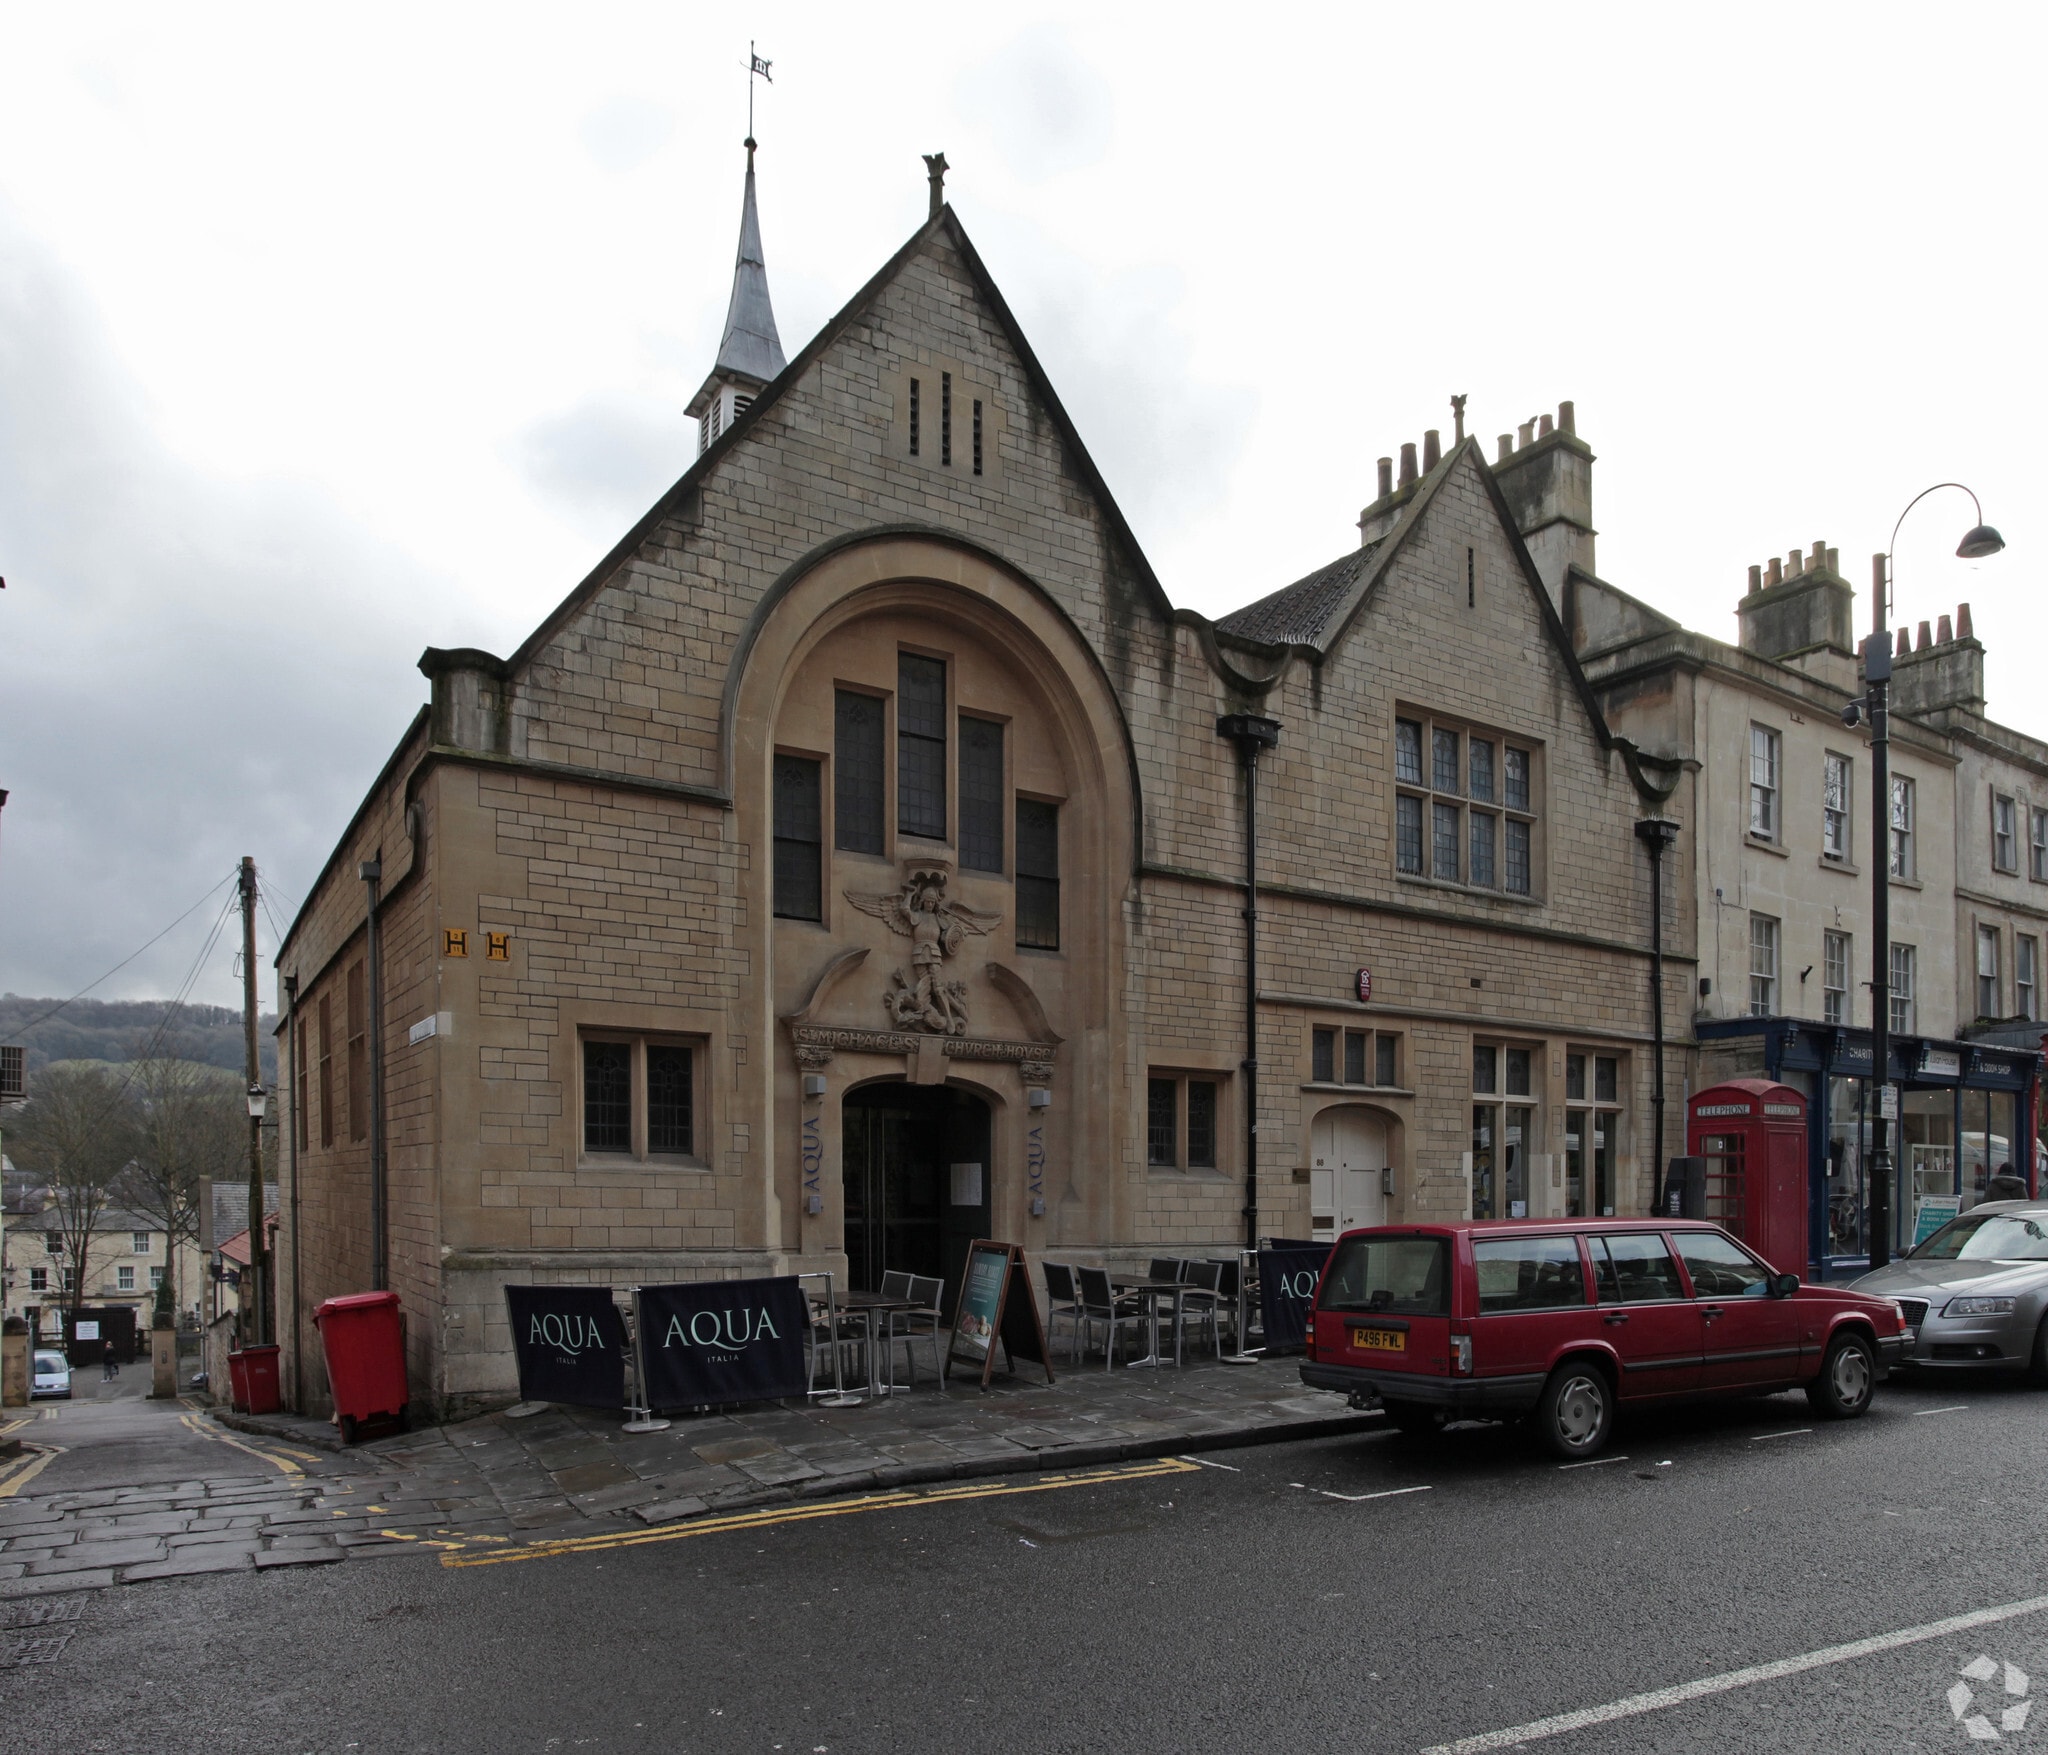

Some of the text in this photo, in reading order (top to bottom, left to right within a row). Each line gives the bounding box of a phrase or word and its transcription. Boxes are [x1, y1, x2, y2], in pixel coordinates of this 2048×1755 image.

[1998, 1064, 2011, 1075] SHOP
[1700, 1104, 1748, 1115] TELEPHONE
[1766, 1104, 1799, 1114] TELEPHONE
[803, 1117, 824, 1192] AQUA
[1028, 1127, 1046, 1195] AQUA
[528, 1313, 606, 1355] AQUA
[662, 1306, 781, 1351] AQUA
[1357, 1330, 1401, 1348] P496 FWL
[556, 1357, 577, 1365] ITALIA
[707, 1354, 739, 1363] ITALIA
